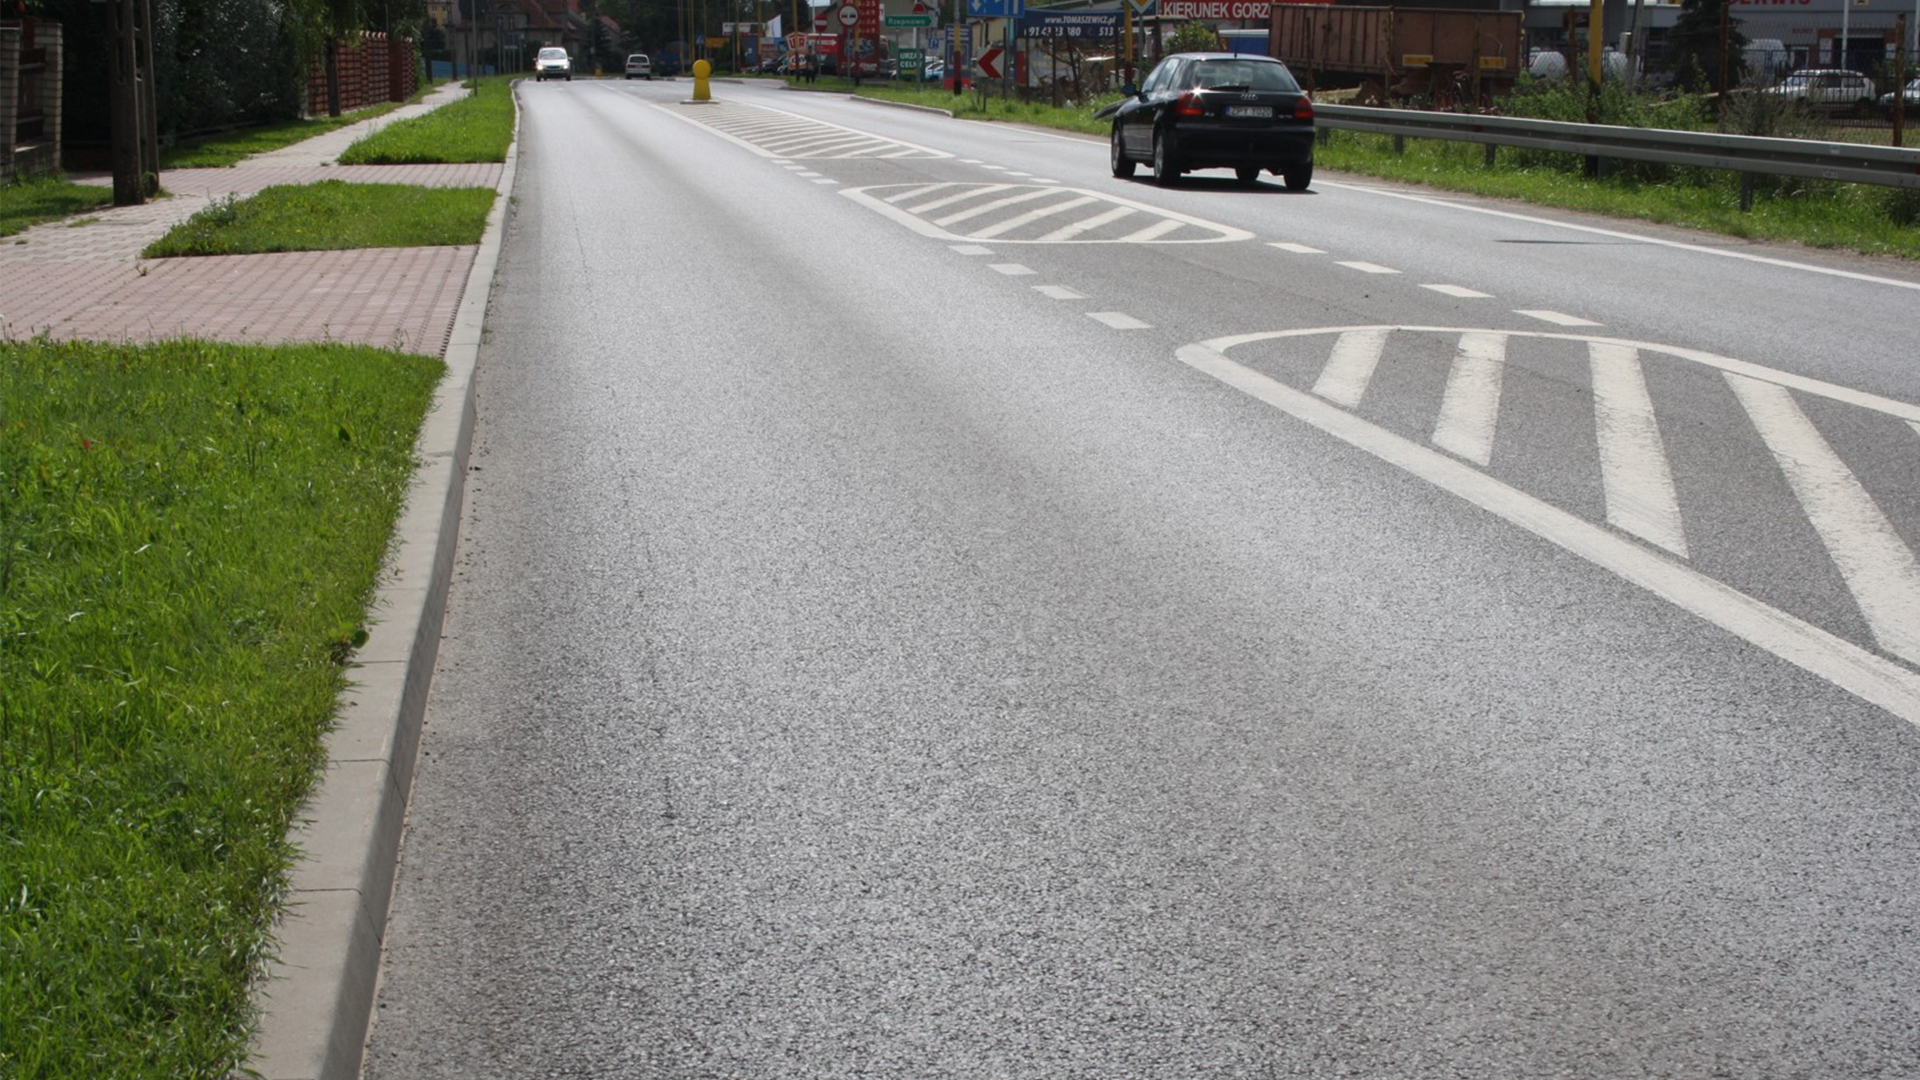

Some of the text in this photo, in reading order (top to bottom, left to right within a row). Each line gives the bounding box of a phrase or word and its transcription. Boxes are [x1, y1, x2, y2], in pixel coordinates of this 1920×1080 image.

[1163, 2, 1271, 18] KIERUNEK GORZ
[1045, 15, 1116, 25] www.TOMASZEWICZ.pl
[1099, 26, 1114, 36] 513
